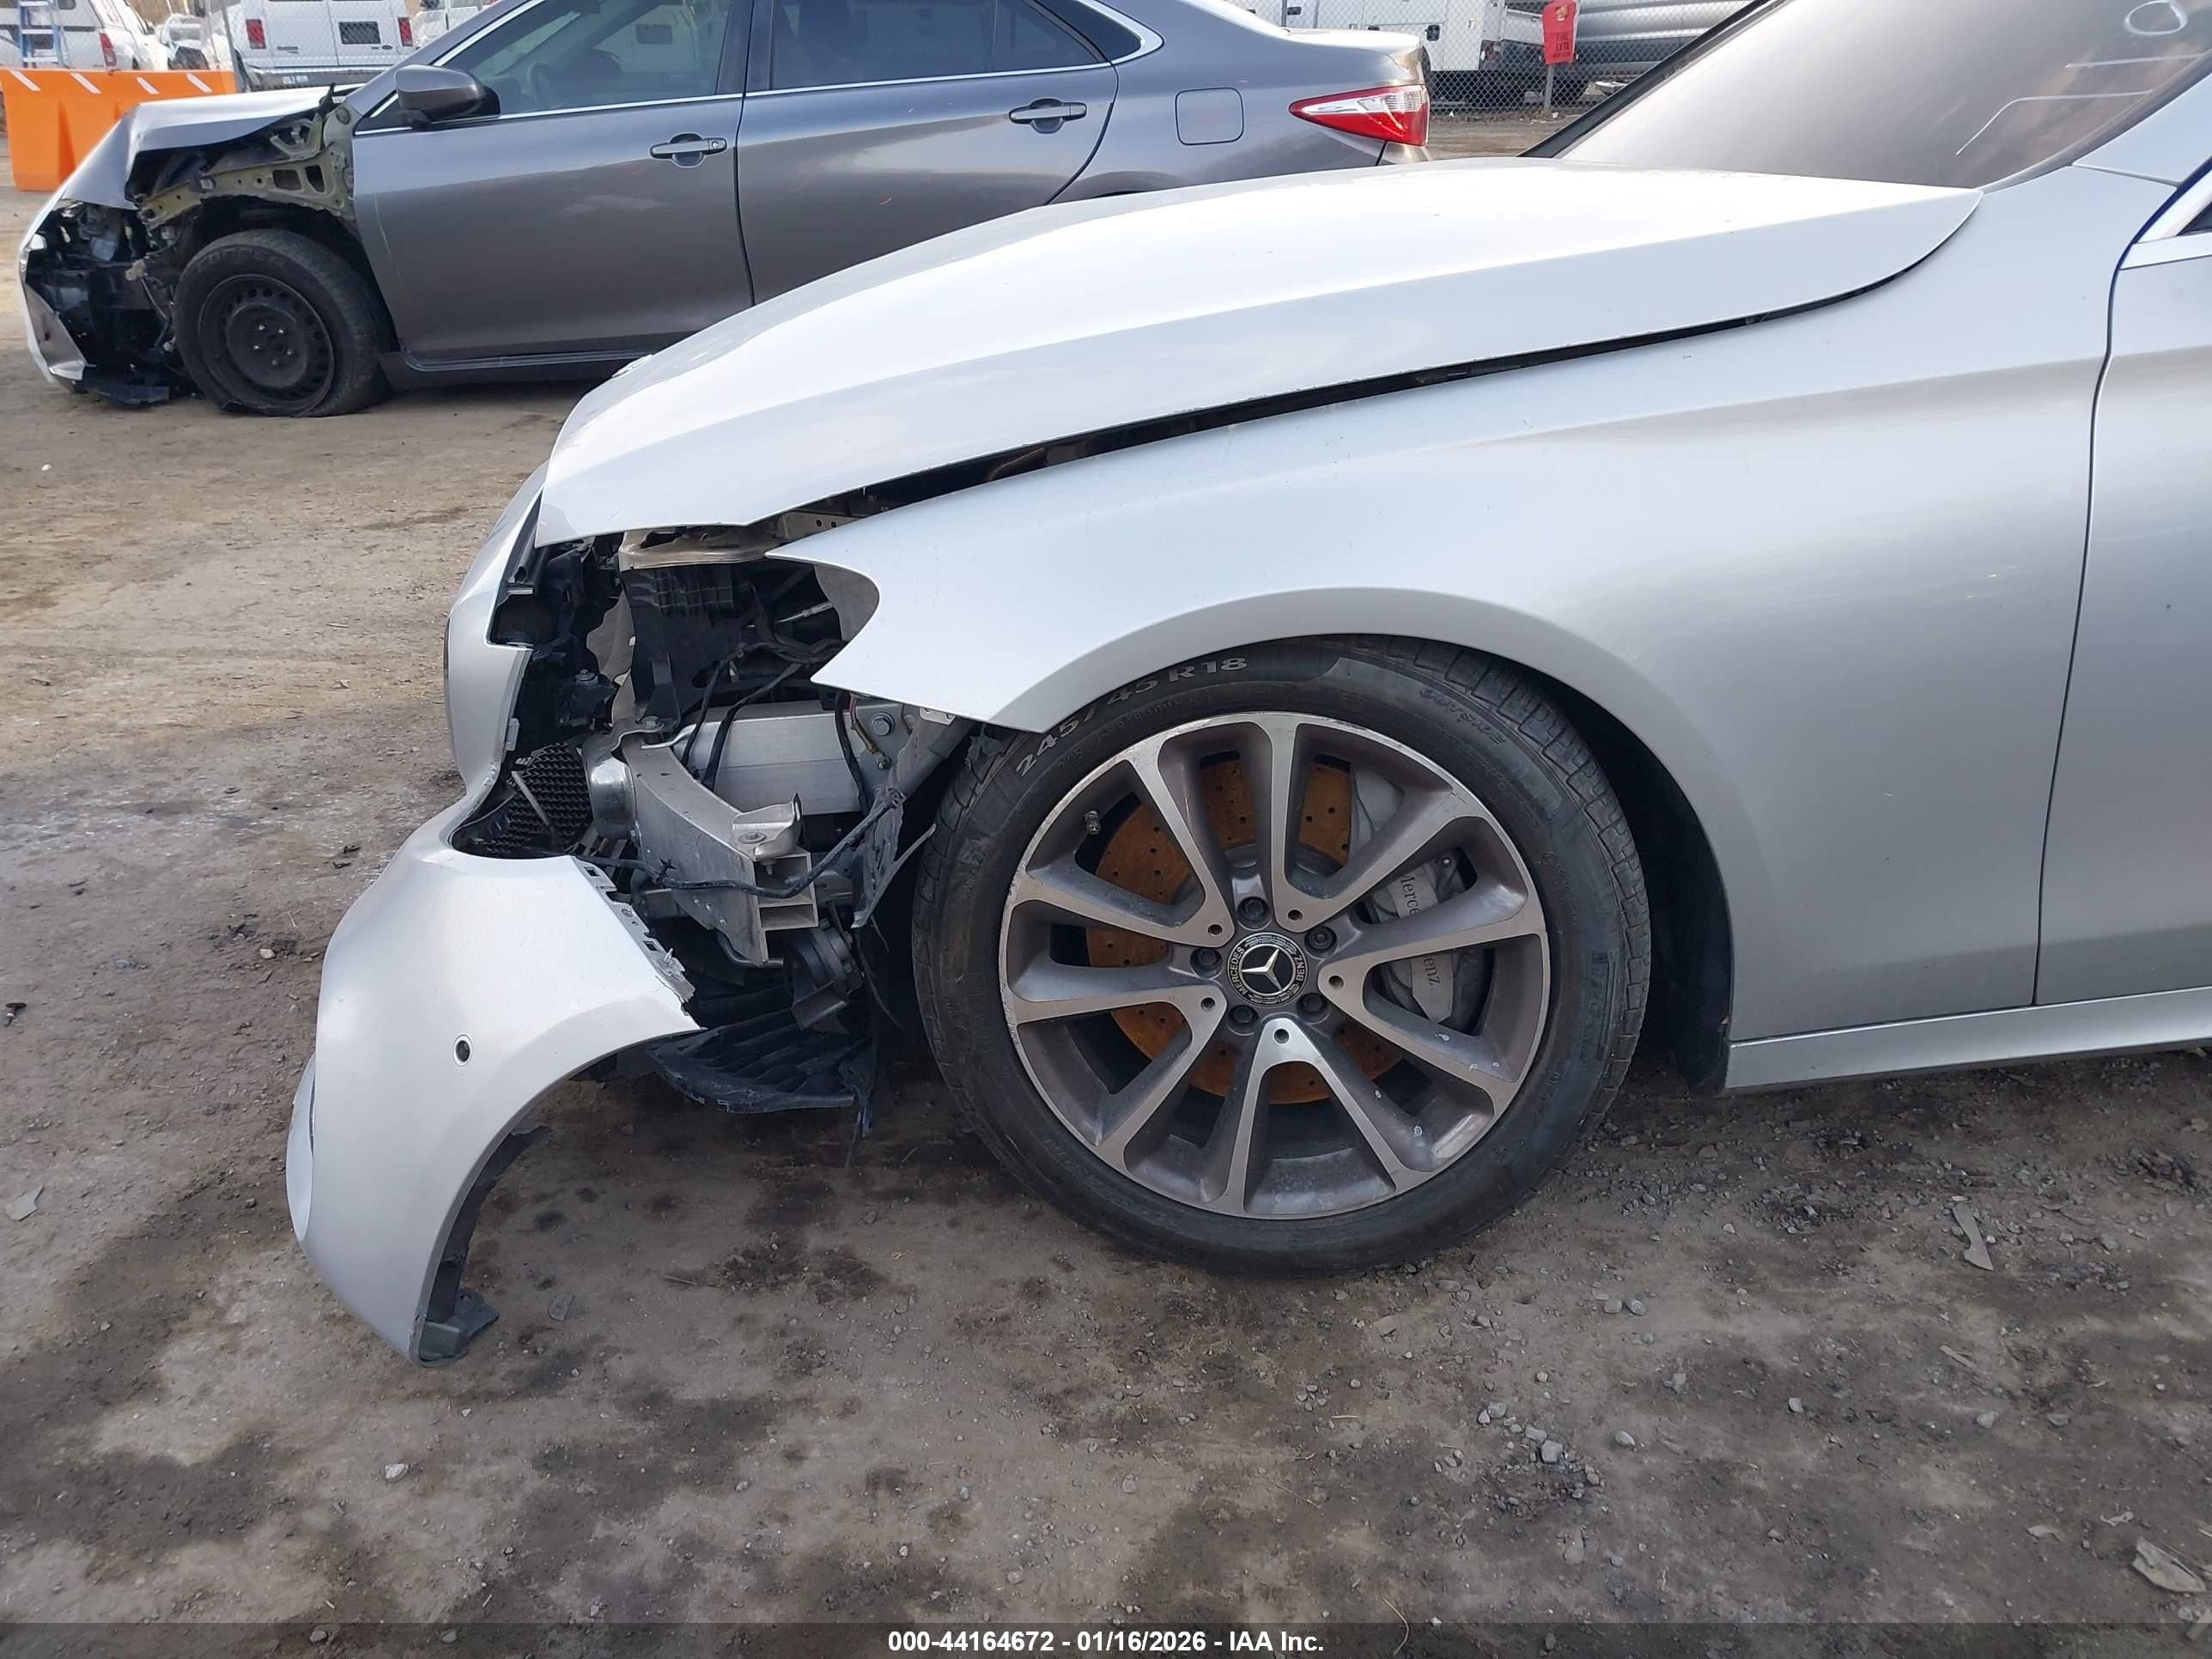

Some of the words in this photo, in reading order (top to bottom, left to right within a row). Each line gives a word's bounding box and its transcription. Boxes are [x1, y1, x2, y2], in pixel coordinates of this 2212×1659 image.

[1168, 657, 1248, 683] R18
[1230, 946, 1249, 995] MERCEDES
[1294, 955, 1305, 981] BENZ
